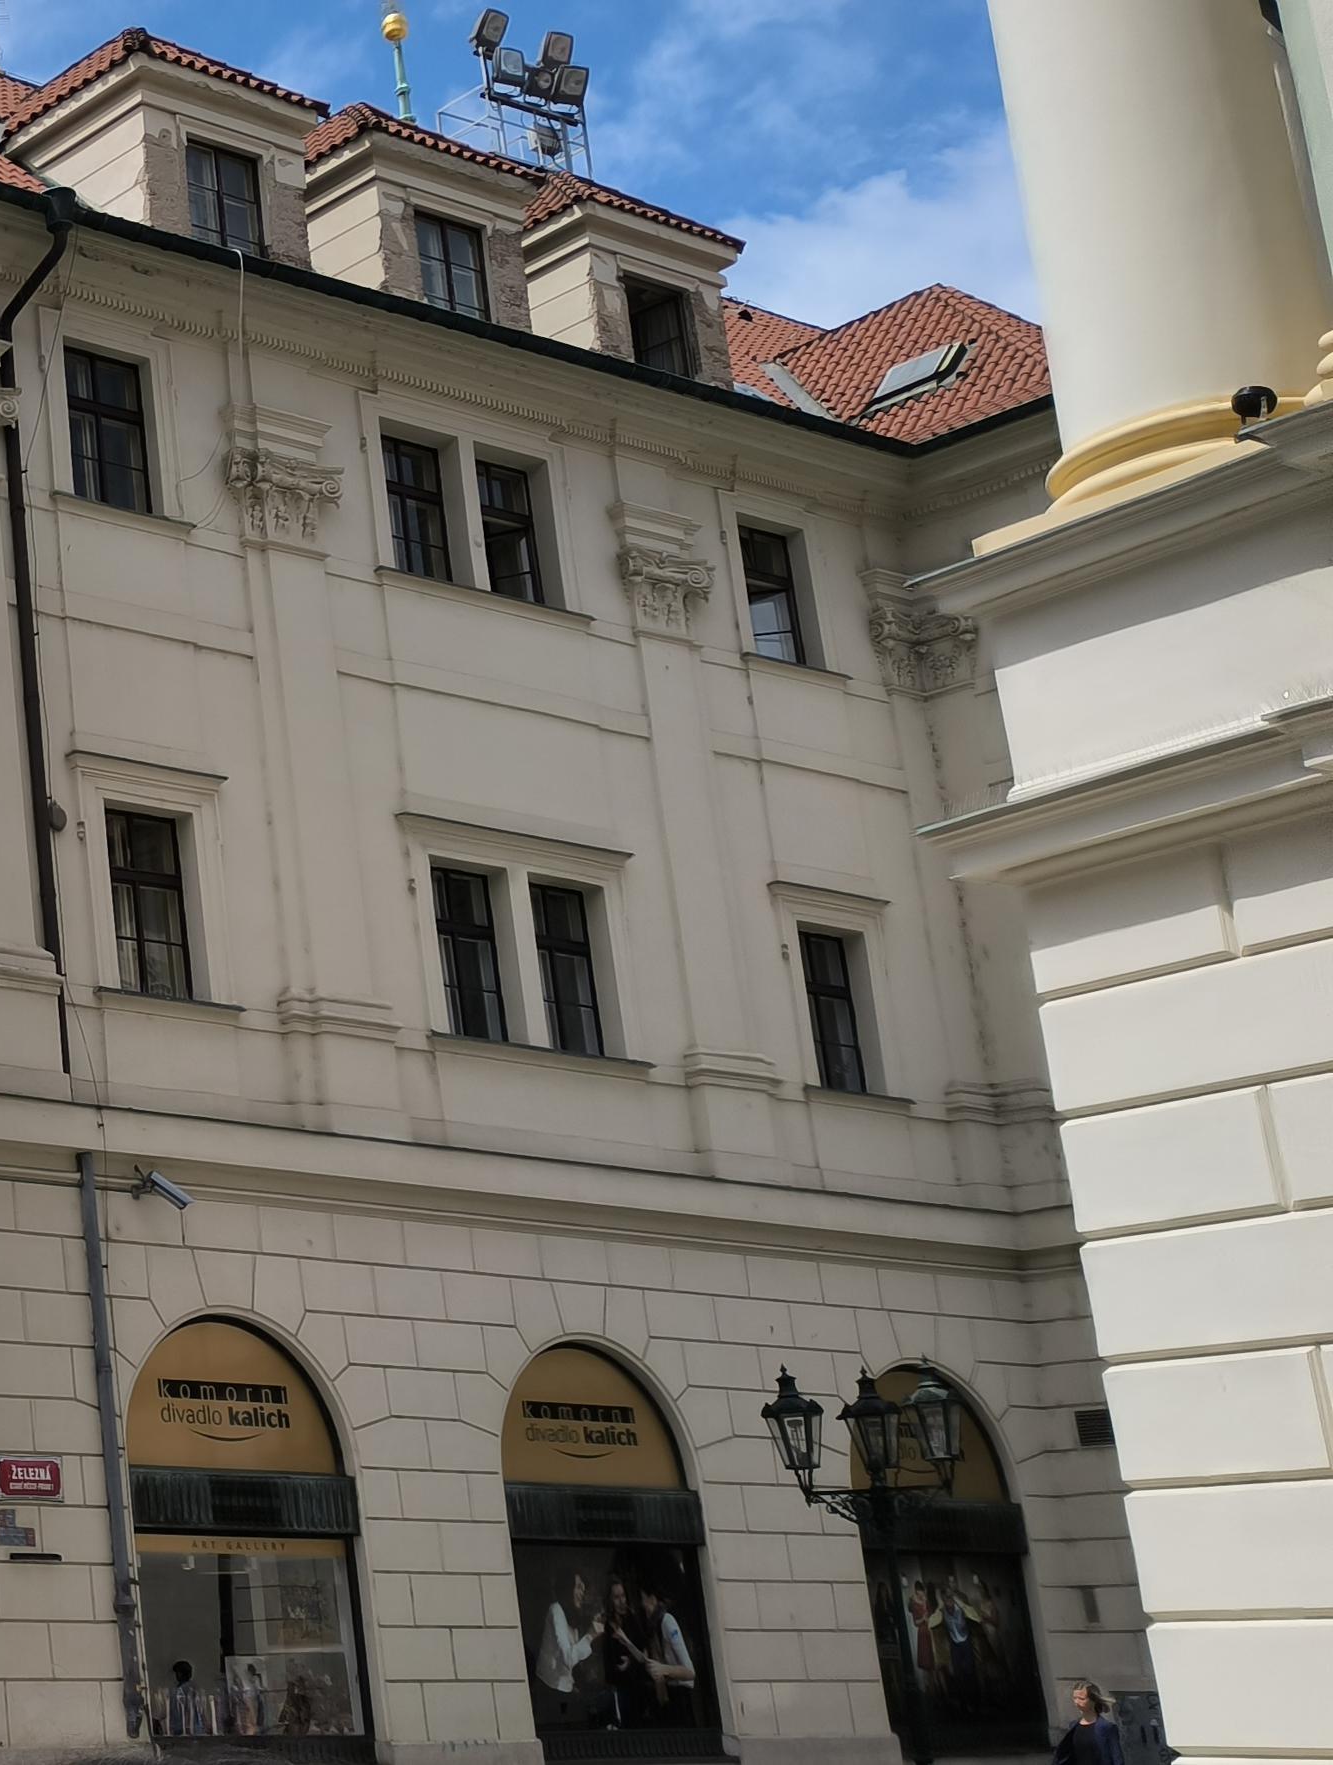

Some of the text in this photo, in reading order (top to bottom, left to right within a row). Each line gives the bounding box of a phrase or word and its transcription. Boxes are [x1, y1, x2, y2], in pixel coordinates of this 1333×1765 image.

[160, 1403, 290, 1428] divadlo kalich
[525, 1423, 638, 1446] divadlo kalich
[11, 1464, 52, 1480] ŽELEZNÁ
[191, 1540, 286, 1551] ART GALLERY
